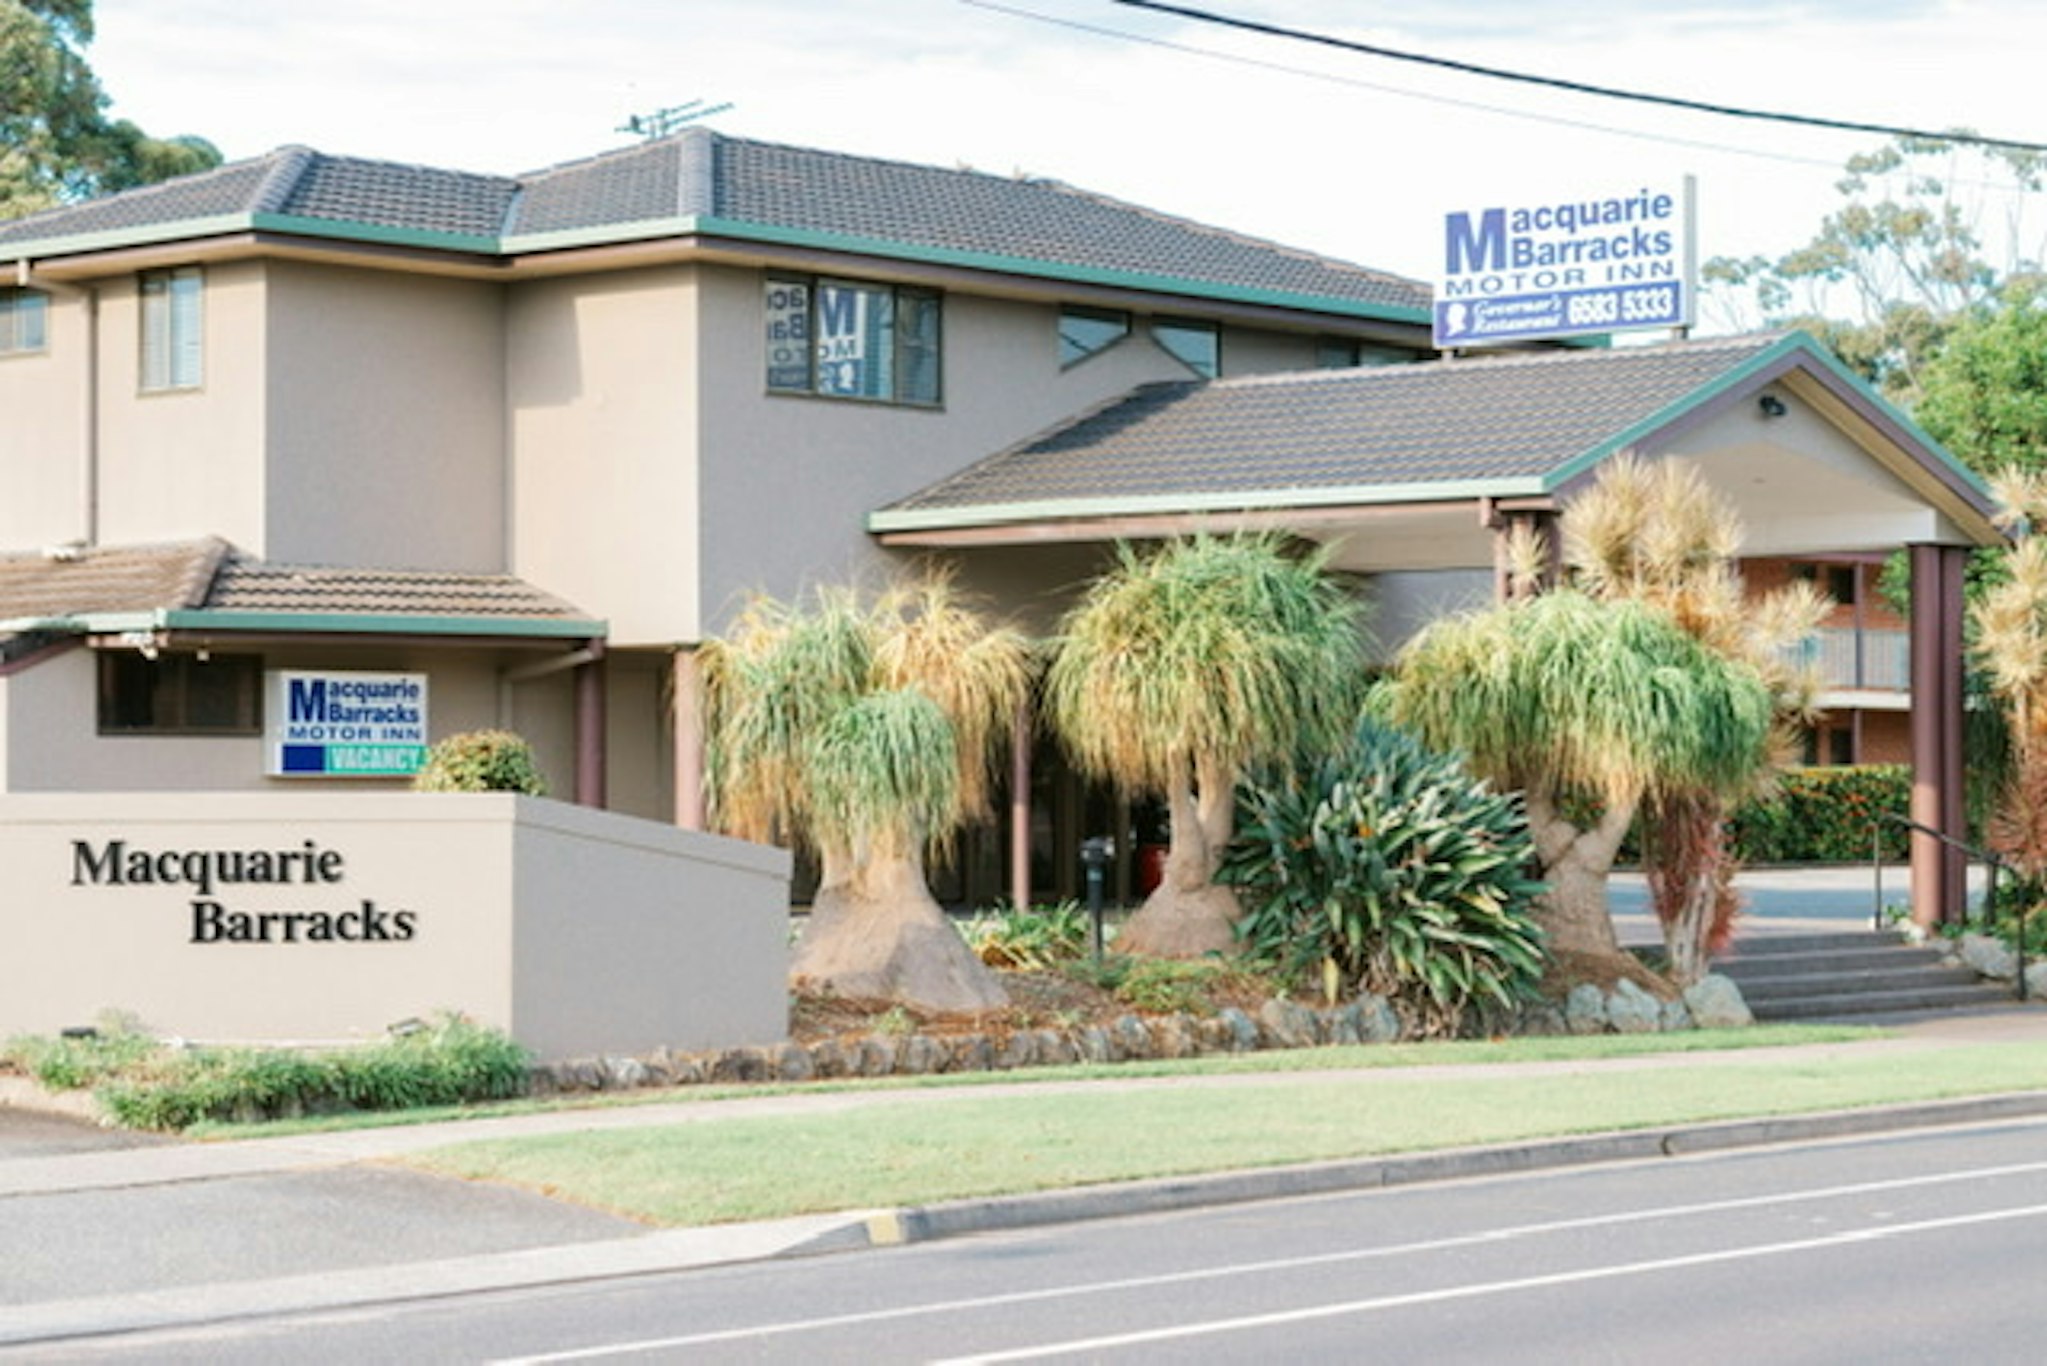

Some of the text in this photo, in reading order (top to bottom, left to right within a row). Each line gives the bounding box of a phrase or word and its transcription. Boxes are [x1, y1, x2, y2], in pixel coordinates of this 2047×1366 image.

[1445, 188, 1673, 275] Macquarie
[1512, 227, 1672, 268] Barracks
[1446, 260, 1673, 297] MOTOR INN
[290, 679, 419, 722] Macquarie
[329, 702, 419, 723] Barracks
[289, 726, 420, 739] MOTOR INN
[331, 748, 420, 769] VACANCY
[70, 839, 344, 895] Macquarie
[189, 899, 417, 943] Barracks
